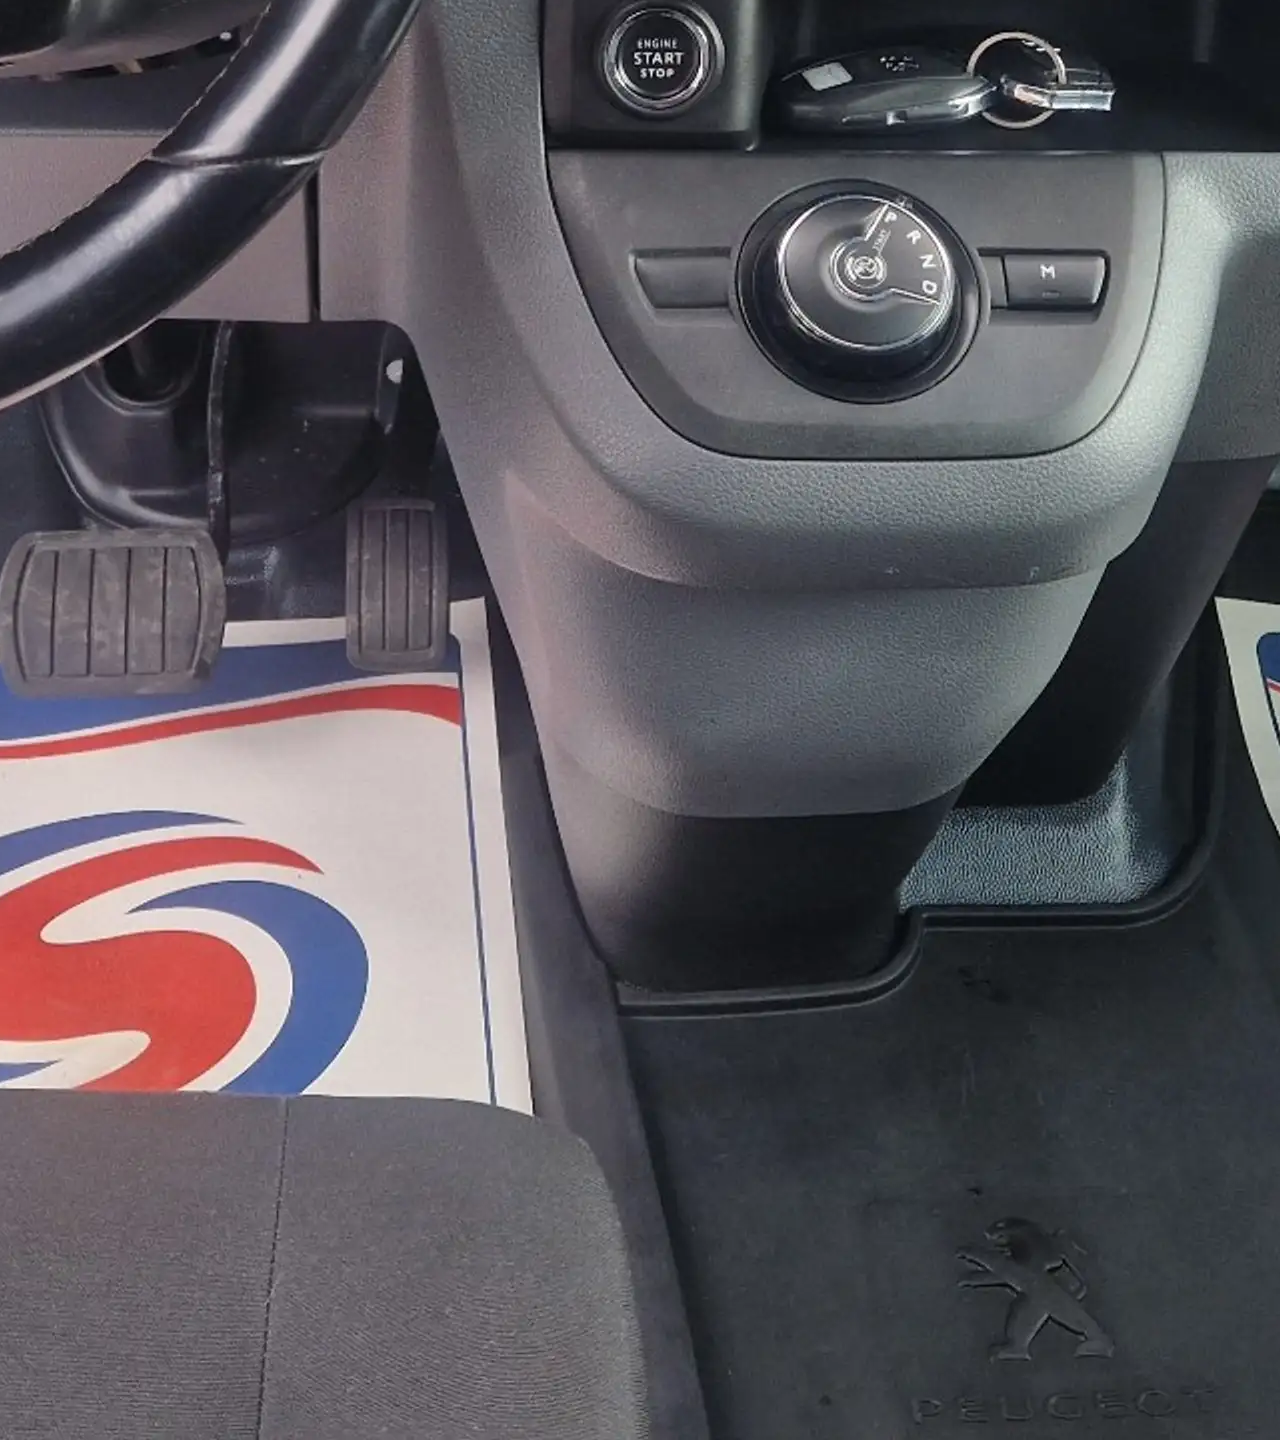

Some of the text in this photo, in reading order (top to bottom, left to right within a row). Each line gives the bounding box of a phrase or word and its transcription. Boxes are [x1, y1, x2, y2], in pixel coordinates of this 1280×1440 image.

[637, 37, 679, 49] ENGINE
[633, 51, 685, 66] START
[639, 67, 676, 79] STOP
[884, 210, 898, 223] P
[906, 229, 922, 245] R
[919, 253, 937, 269] N
[1040, 263, 1056, 279] M
[921, 279, 938, 295] D
[911, 1383, 1219, 1424] PEUGEOT
